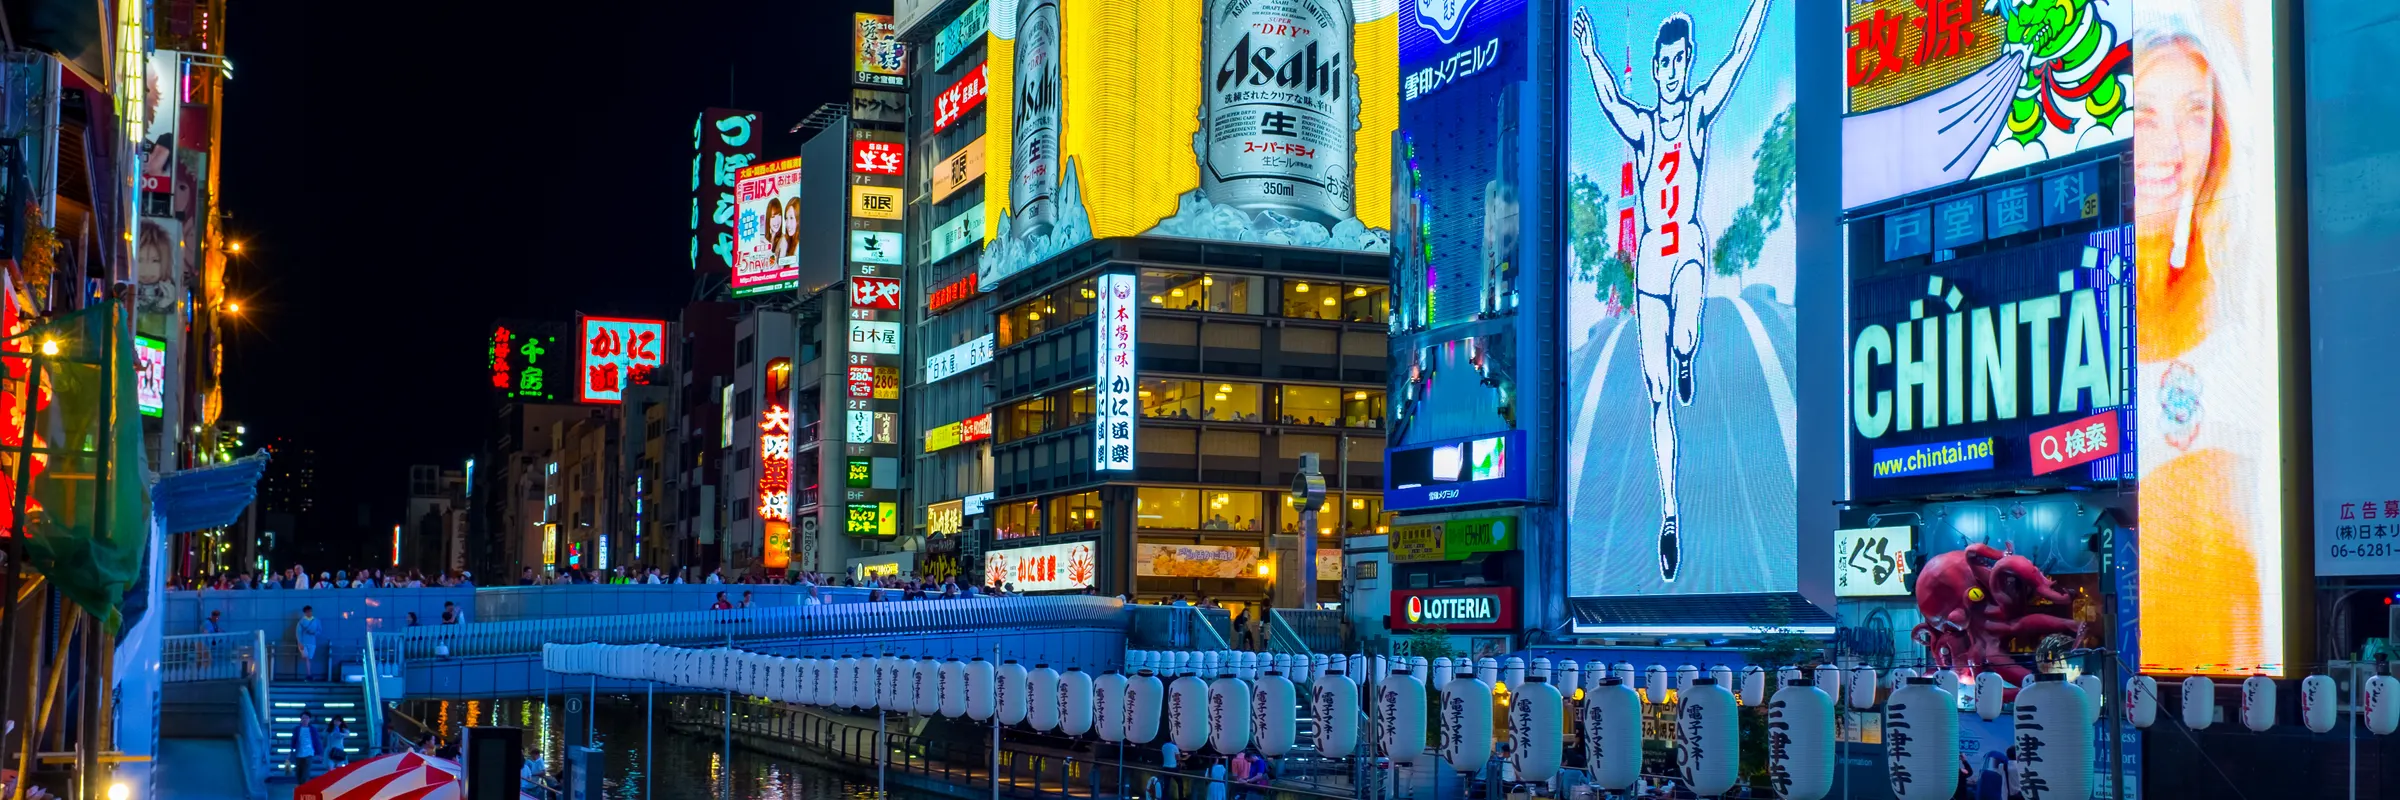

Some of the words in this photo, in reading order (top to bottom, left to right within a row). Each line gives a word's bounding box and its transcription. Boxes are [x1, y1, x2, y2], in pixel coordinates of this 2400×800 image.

[1845, 0, 1975, 88] 改源
[859, 72, 872, 83] 9F
[1217, 32, 1340, 102] Asahi
[1404, 37, 1498, 101] 雪印メグミルク
[1016, 58, 1056, 137] Asahi
[1261, 111, 1297, 137] 生
[1029, 137, 1041, 163] 生
[1244, 142, 1315, 159] スーパードライ
[742, 177, 779, 202] 高収入
[863, 195, 891, 210] 和民
[1264, 182, 1294, 196] 350ml
[1658, 142, 1682, 257] グリコ
[2084, 201, 2097, 216] 3F
[861, 265, 875, 274] 5F
[852, 281, 900, 306] はや
[590, 327, 656, 360] かに
[853, 326, 896, 344] 白木屋
[1115, 305, 1129, 368] 本場の味
[1854, 266, 2127, 439] CHINTAI
[520, 338, 545, 390] 千房
[933, 353, 955, 379] 白木屋
[1112, 375, 1130, 463] かに道楽
[2065, 422, 2108, 457] 検索
[848, 520, 876, 532] ドンキー
[849, 508, 875, 521] びっくり
[804, 532, 813, 552] ZERO
[2103, 528, 2112, 573] 2F
[1018, 554, 1056, 583] かに道楽
[1424, 598, 1491, 619] LOTTERIA
[1322, 691, 1334, 740] 電子マネー
[1385, 691, 1398, 745] 電子マネー
[1451, 698, 1464, 754] 電子マネー
[1519, 699, 1532, 758] 電子マネー
[1590, 706, 1604, 769] 電子マネー
[1687, 704, 1704, 770] 電子マネー
[1769, 700, 1792, 795] 三津寺
[1887, 704, 1913, 796] 三津寺
[2014, 705, 2049, 800] 三津寺
